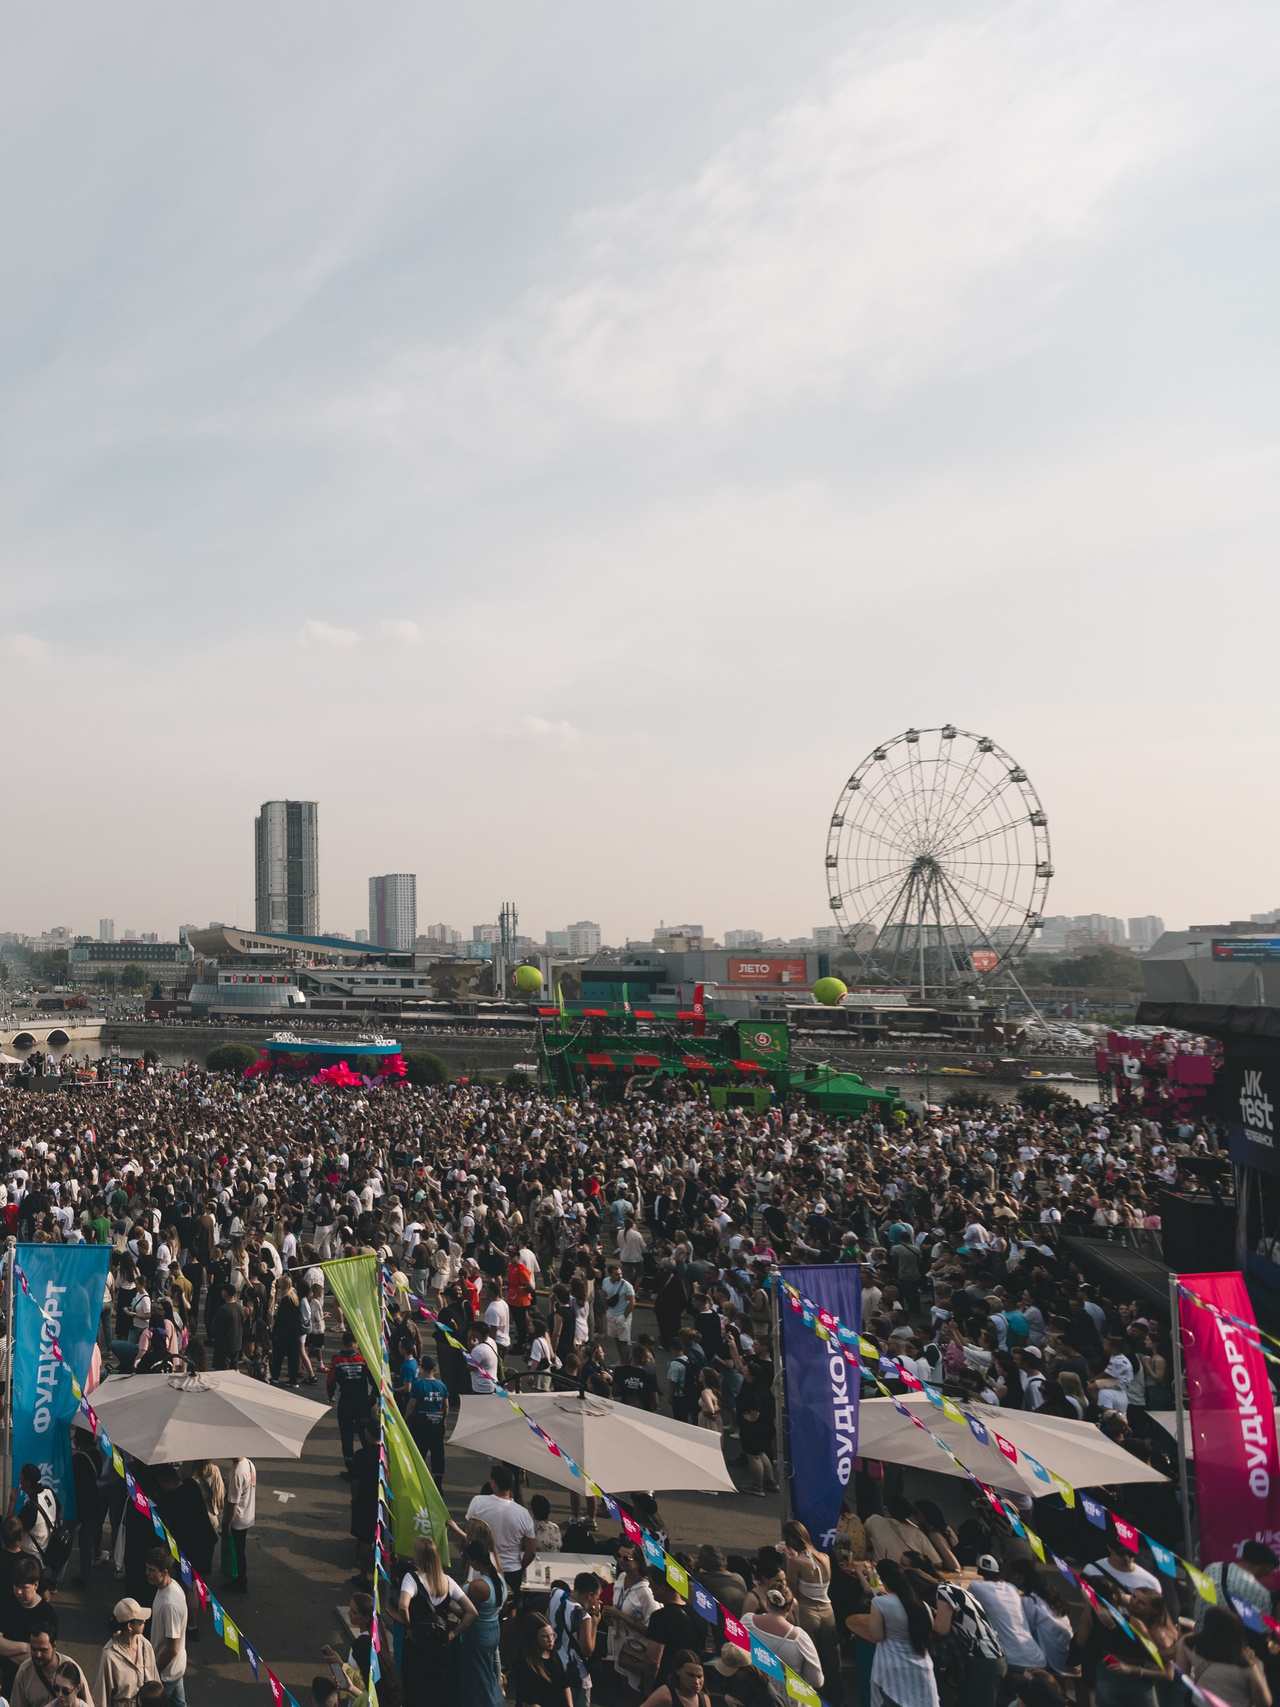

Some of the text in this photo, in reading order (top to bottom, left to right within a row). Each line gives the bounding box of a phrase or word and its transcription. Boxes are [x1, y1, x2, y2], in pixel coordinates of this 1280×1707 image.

[739, 964, 770, 973] ЛЕТО
[1244, 1070, 1263, 1098] VK
[1239, 1086, 1274, 1130] fest
